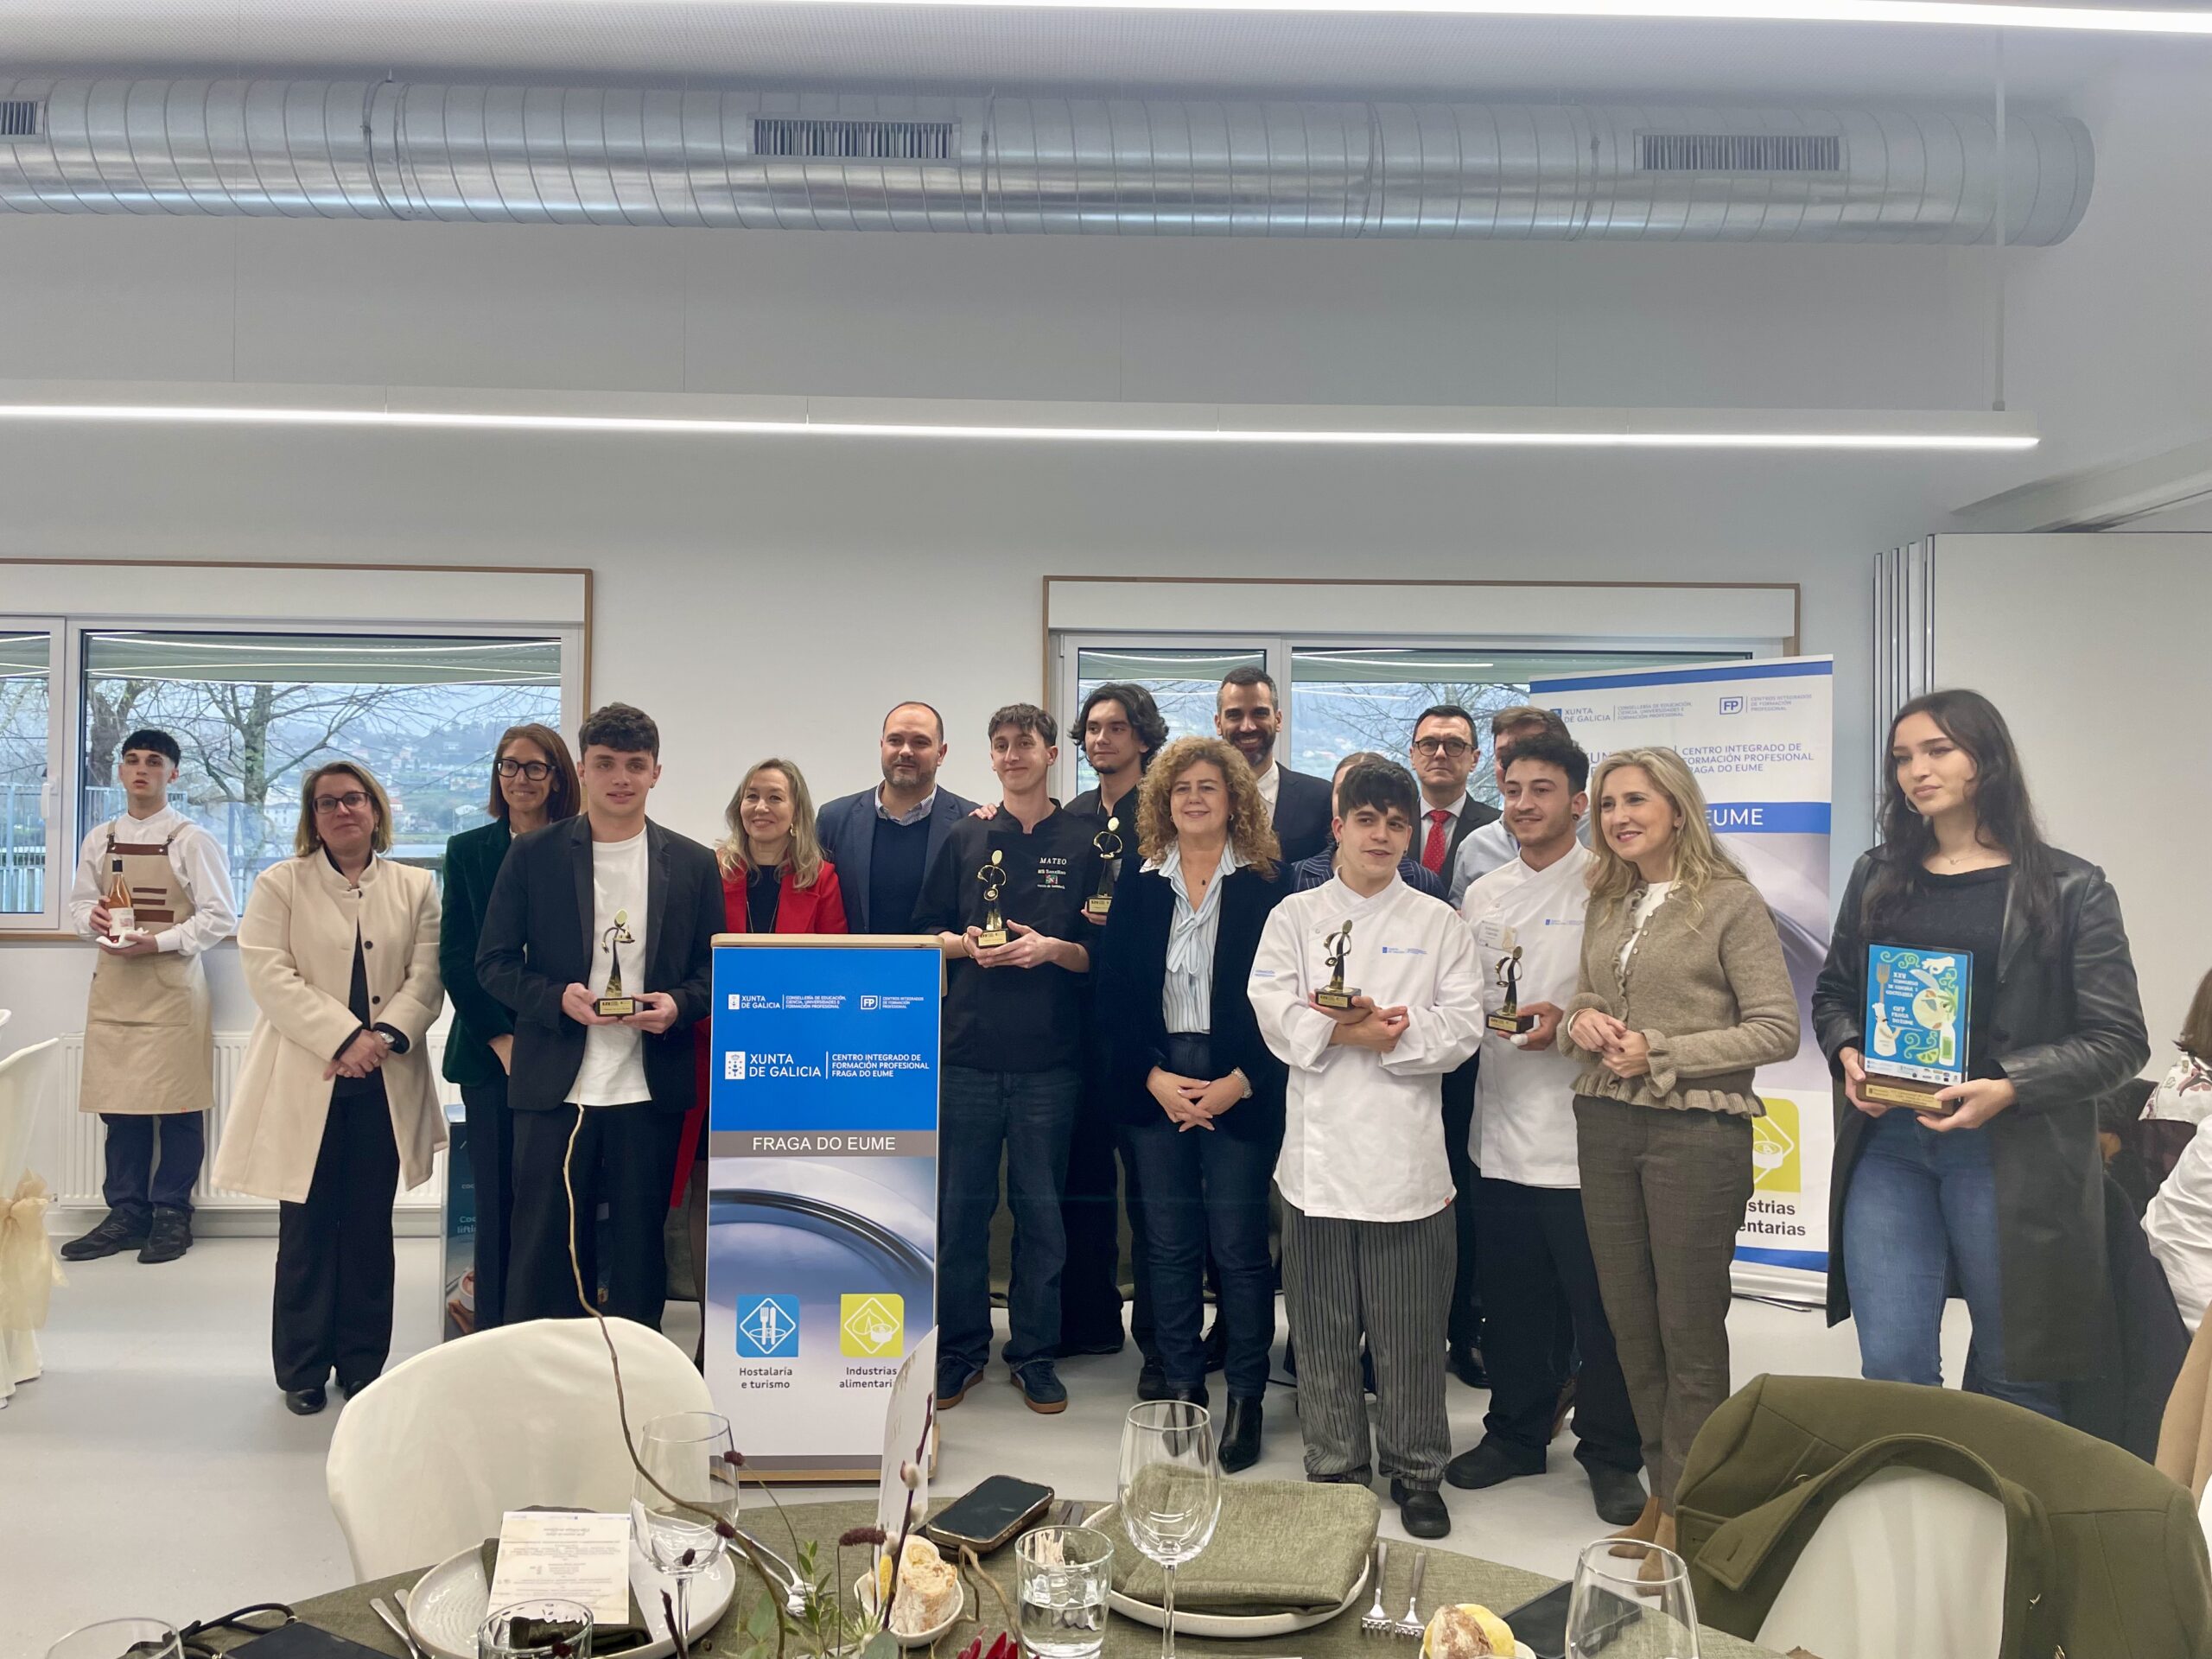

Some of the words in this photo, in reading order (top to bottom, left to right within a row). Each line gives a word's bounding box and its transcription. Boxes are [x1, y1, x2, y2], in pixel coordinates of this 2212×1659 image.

[1724, 701, 1738, 711] FP
[1682, 746, 1722, 755] CENTRO
[1725, 744, 1787, 753] INTEGRADO
[1745, 753, 1814, 762] PROFESIONAL
[1690, 766, 1714, 774] RAGA
[749, 1054, 794, 1065] XUNTA
[749, 1066, 766, 1077] DE
[770, 1066, 822, 1077] GALICIA
[753, 1137, 811, 1150] FRAGA
[817, 1137, 842, 1150] DO
[848, 1137, 896, 1150] EUME
[1748, 1199, 1796, 1215] strias
[1738, 1220, 1806, 1236] entarias
[739, 1367, 792, 1376] Hostalaría
[846, 1367, 898, 1376] Industrias
[750, 1380, 790, 1389] turismo
[839, 1379, 893, 1389] alimentari
